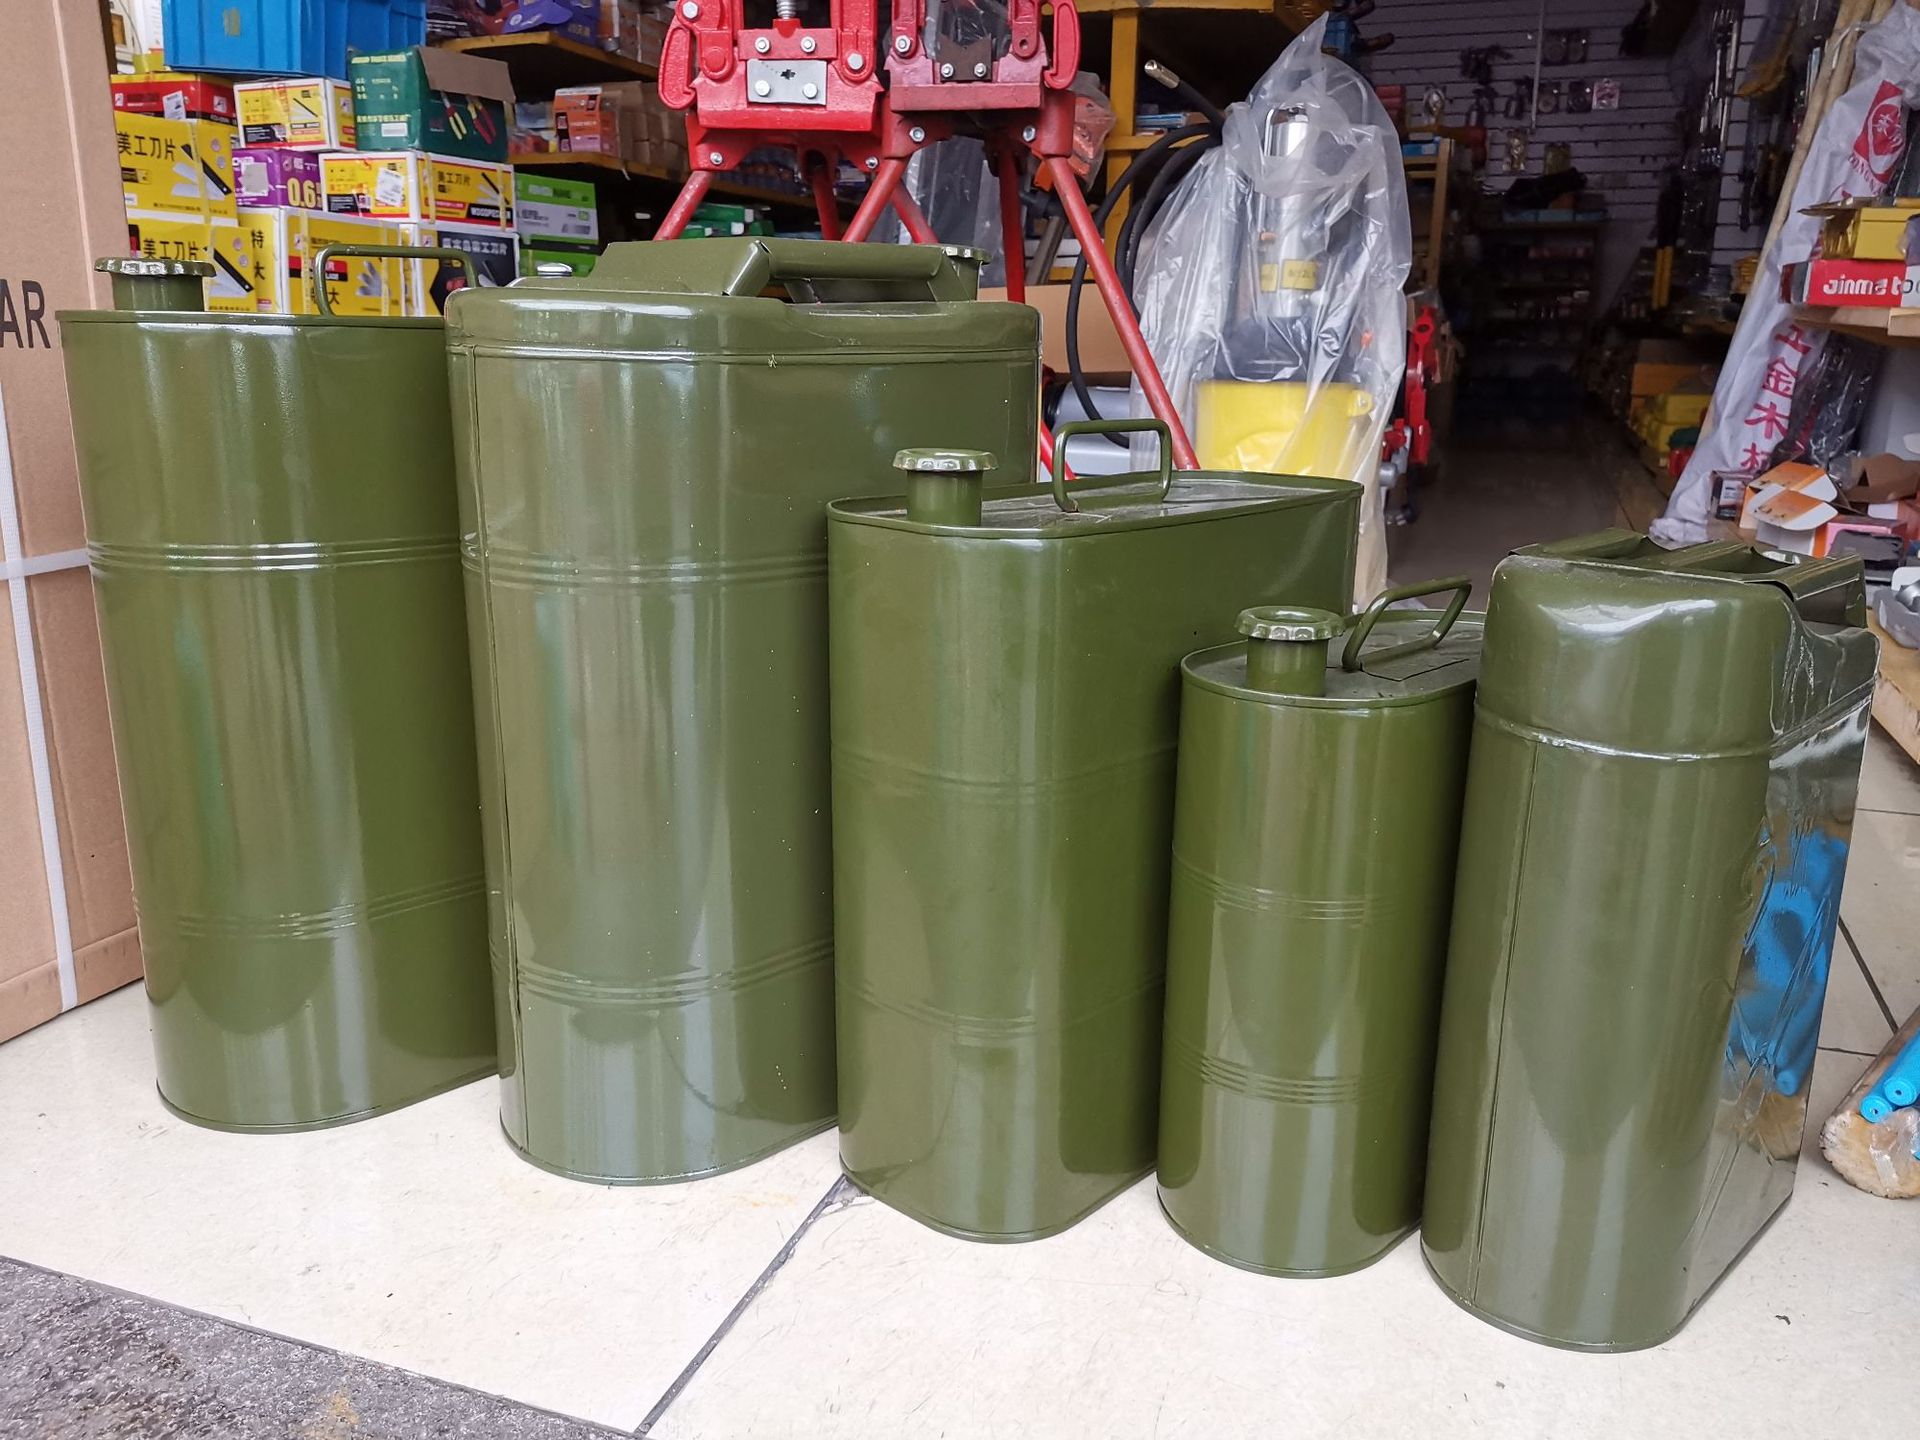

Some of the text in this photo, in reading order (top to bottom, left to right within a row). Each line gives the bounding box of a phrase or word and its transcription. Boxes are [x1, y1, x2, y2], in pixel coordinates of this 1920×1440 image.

[117, 132, 176, 161] 美工刀片
[143, 238, 199, 260] 美工刀片
